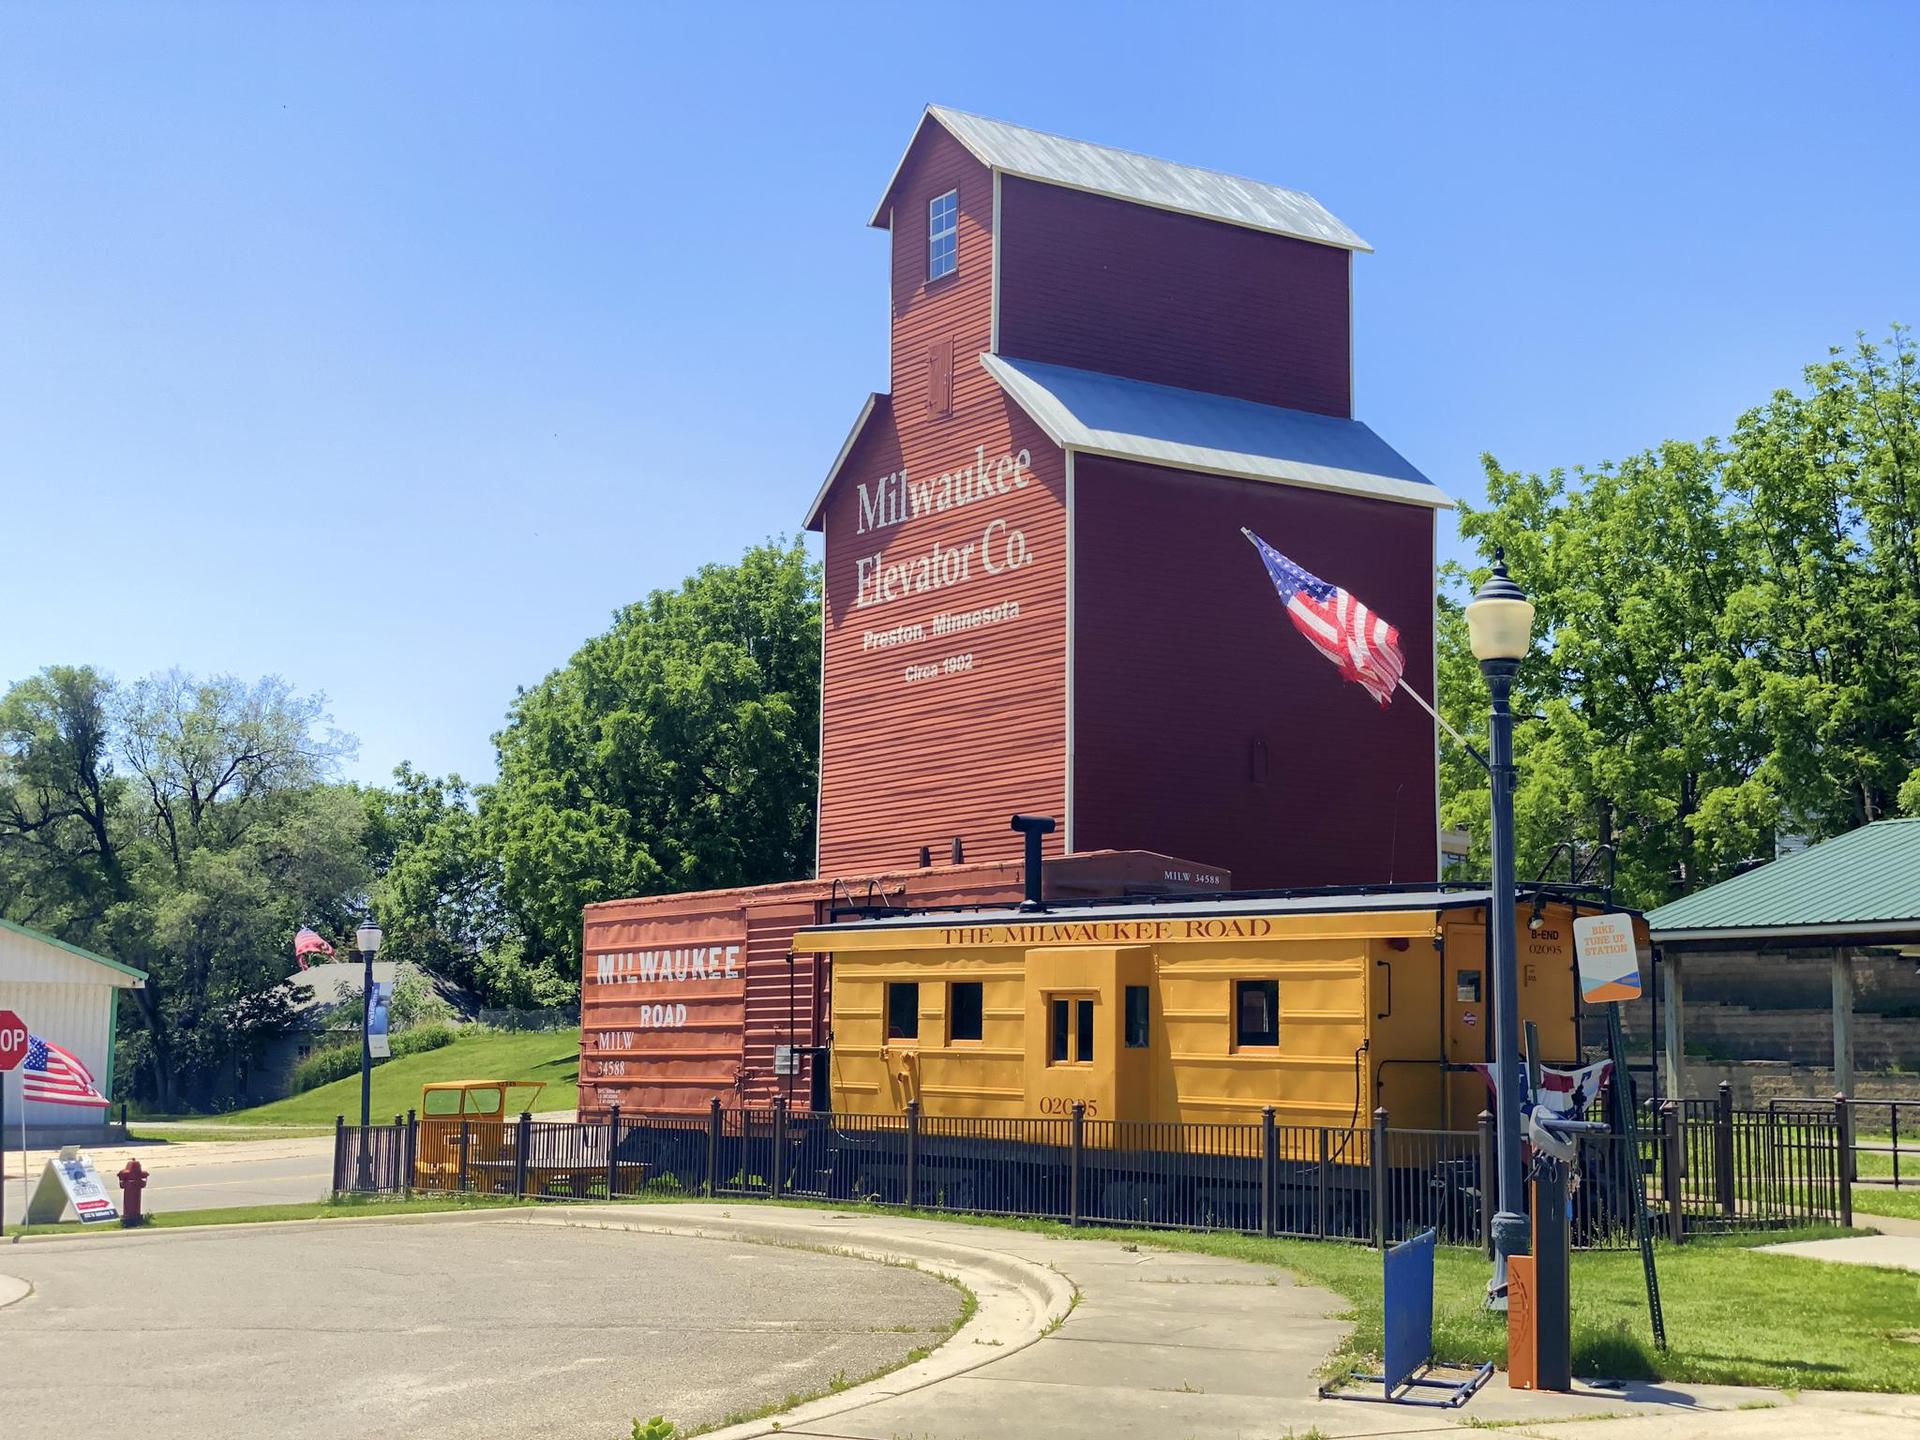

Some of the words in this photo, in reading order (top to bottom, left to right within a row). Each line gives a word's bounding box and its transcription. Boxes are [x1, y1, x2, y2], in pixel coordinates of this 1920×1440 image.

[856, 444, 1032, 535] Milwaukee
[855, 541, 975, 609] Elevator
[981, 518, 1033, 576] Co.
[863, 621, 927, 652] Preston,
[932, 599, 1020, 636] Minnesota
[904, 661, 938, 683] Circa
[942, 653, 973, 676] 1902
[1164, 870, 1191, 881] MILW
[1195, 873, 1220, 885] 34588
[940, 927, 993, 944] THE
[1004, 921, 1172, 943] MILWAUKEE
[1186, 918, 1272, 938] ROAD
[1531, 929, 1559, 940] B-END
[1584, 935, 1610, 946] TUNE
[1613, 933, 1625, 943] UP
[1592, 924, 1615, 935] BIKE
[1529, 944, 1562, 955] 02095
[1584, 943, 1628, 956] STATION
[596, 945, 740, 986] MILWAUKEE
[639, 1003, 687, 1029] ROAD
[599, 1031, 635, 1051] MILW
[597, 1061, 625, 1077] 34588
